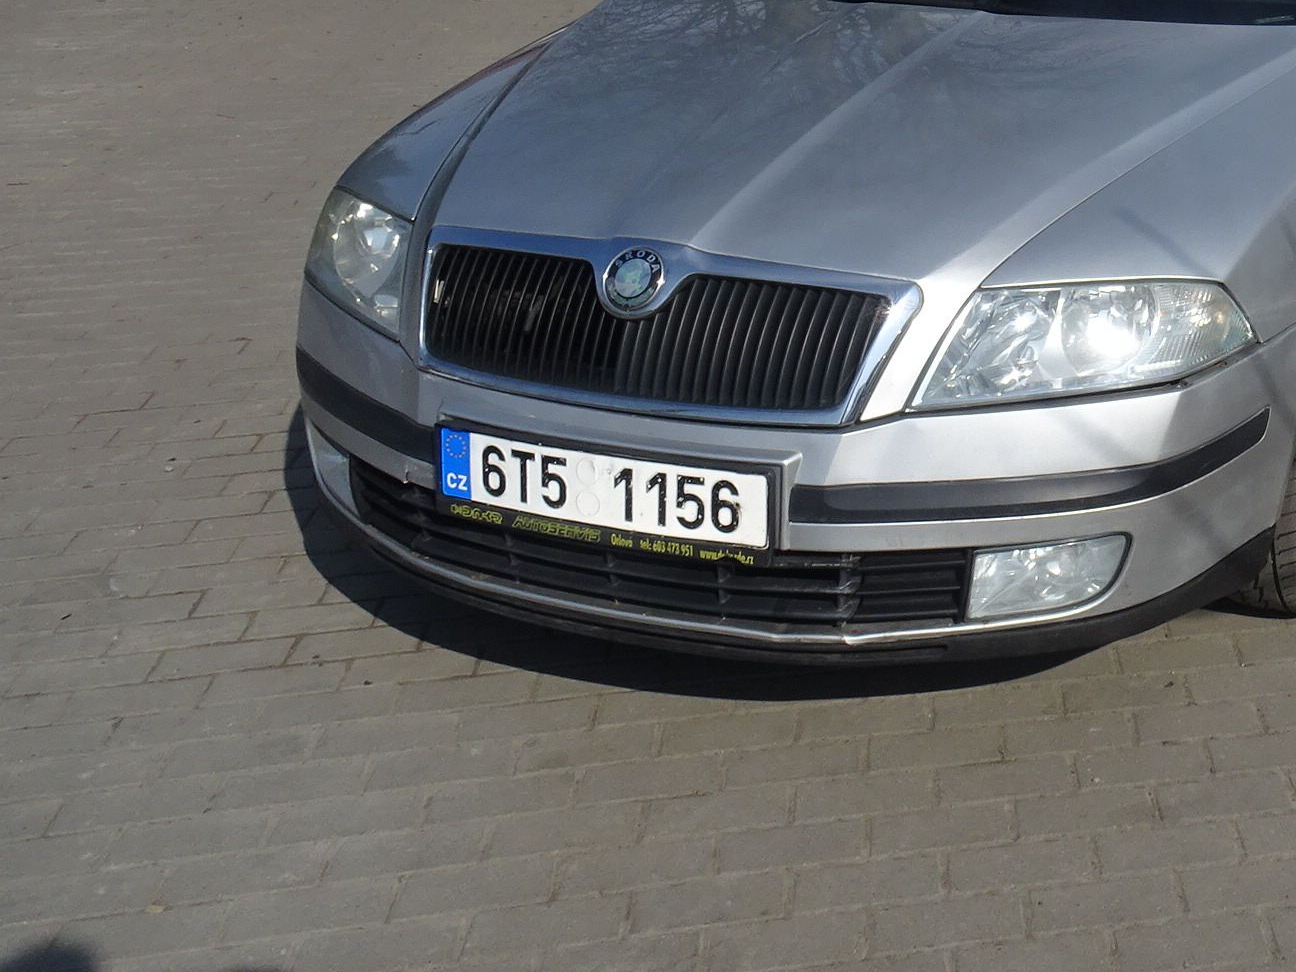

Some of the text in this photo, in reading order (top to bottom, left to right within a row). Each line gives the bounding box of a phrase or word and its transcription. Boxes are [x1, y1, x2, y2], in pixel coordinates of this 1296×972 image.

[446, 472, 468, 491] CZ
[481, 445, 740, 534] 6T5 1156
